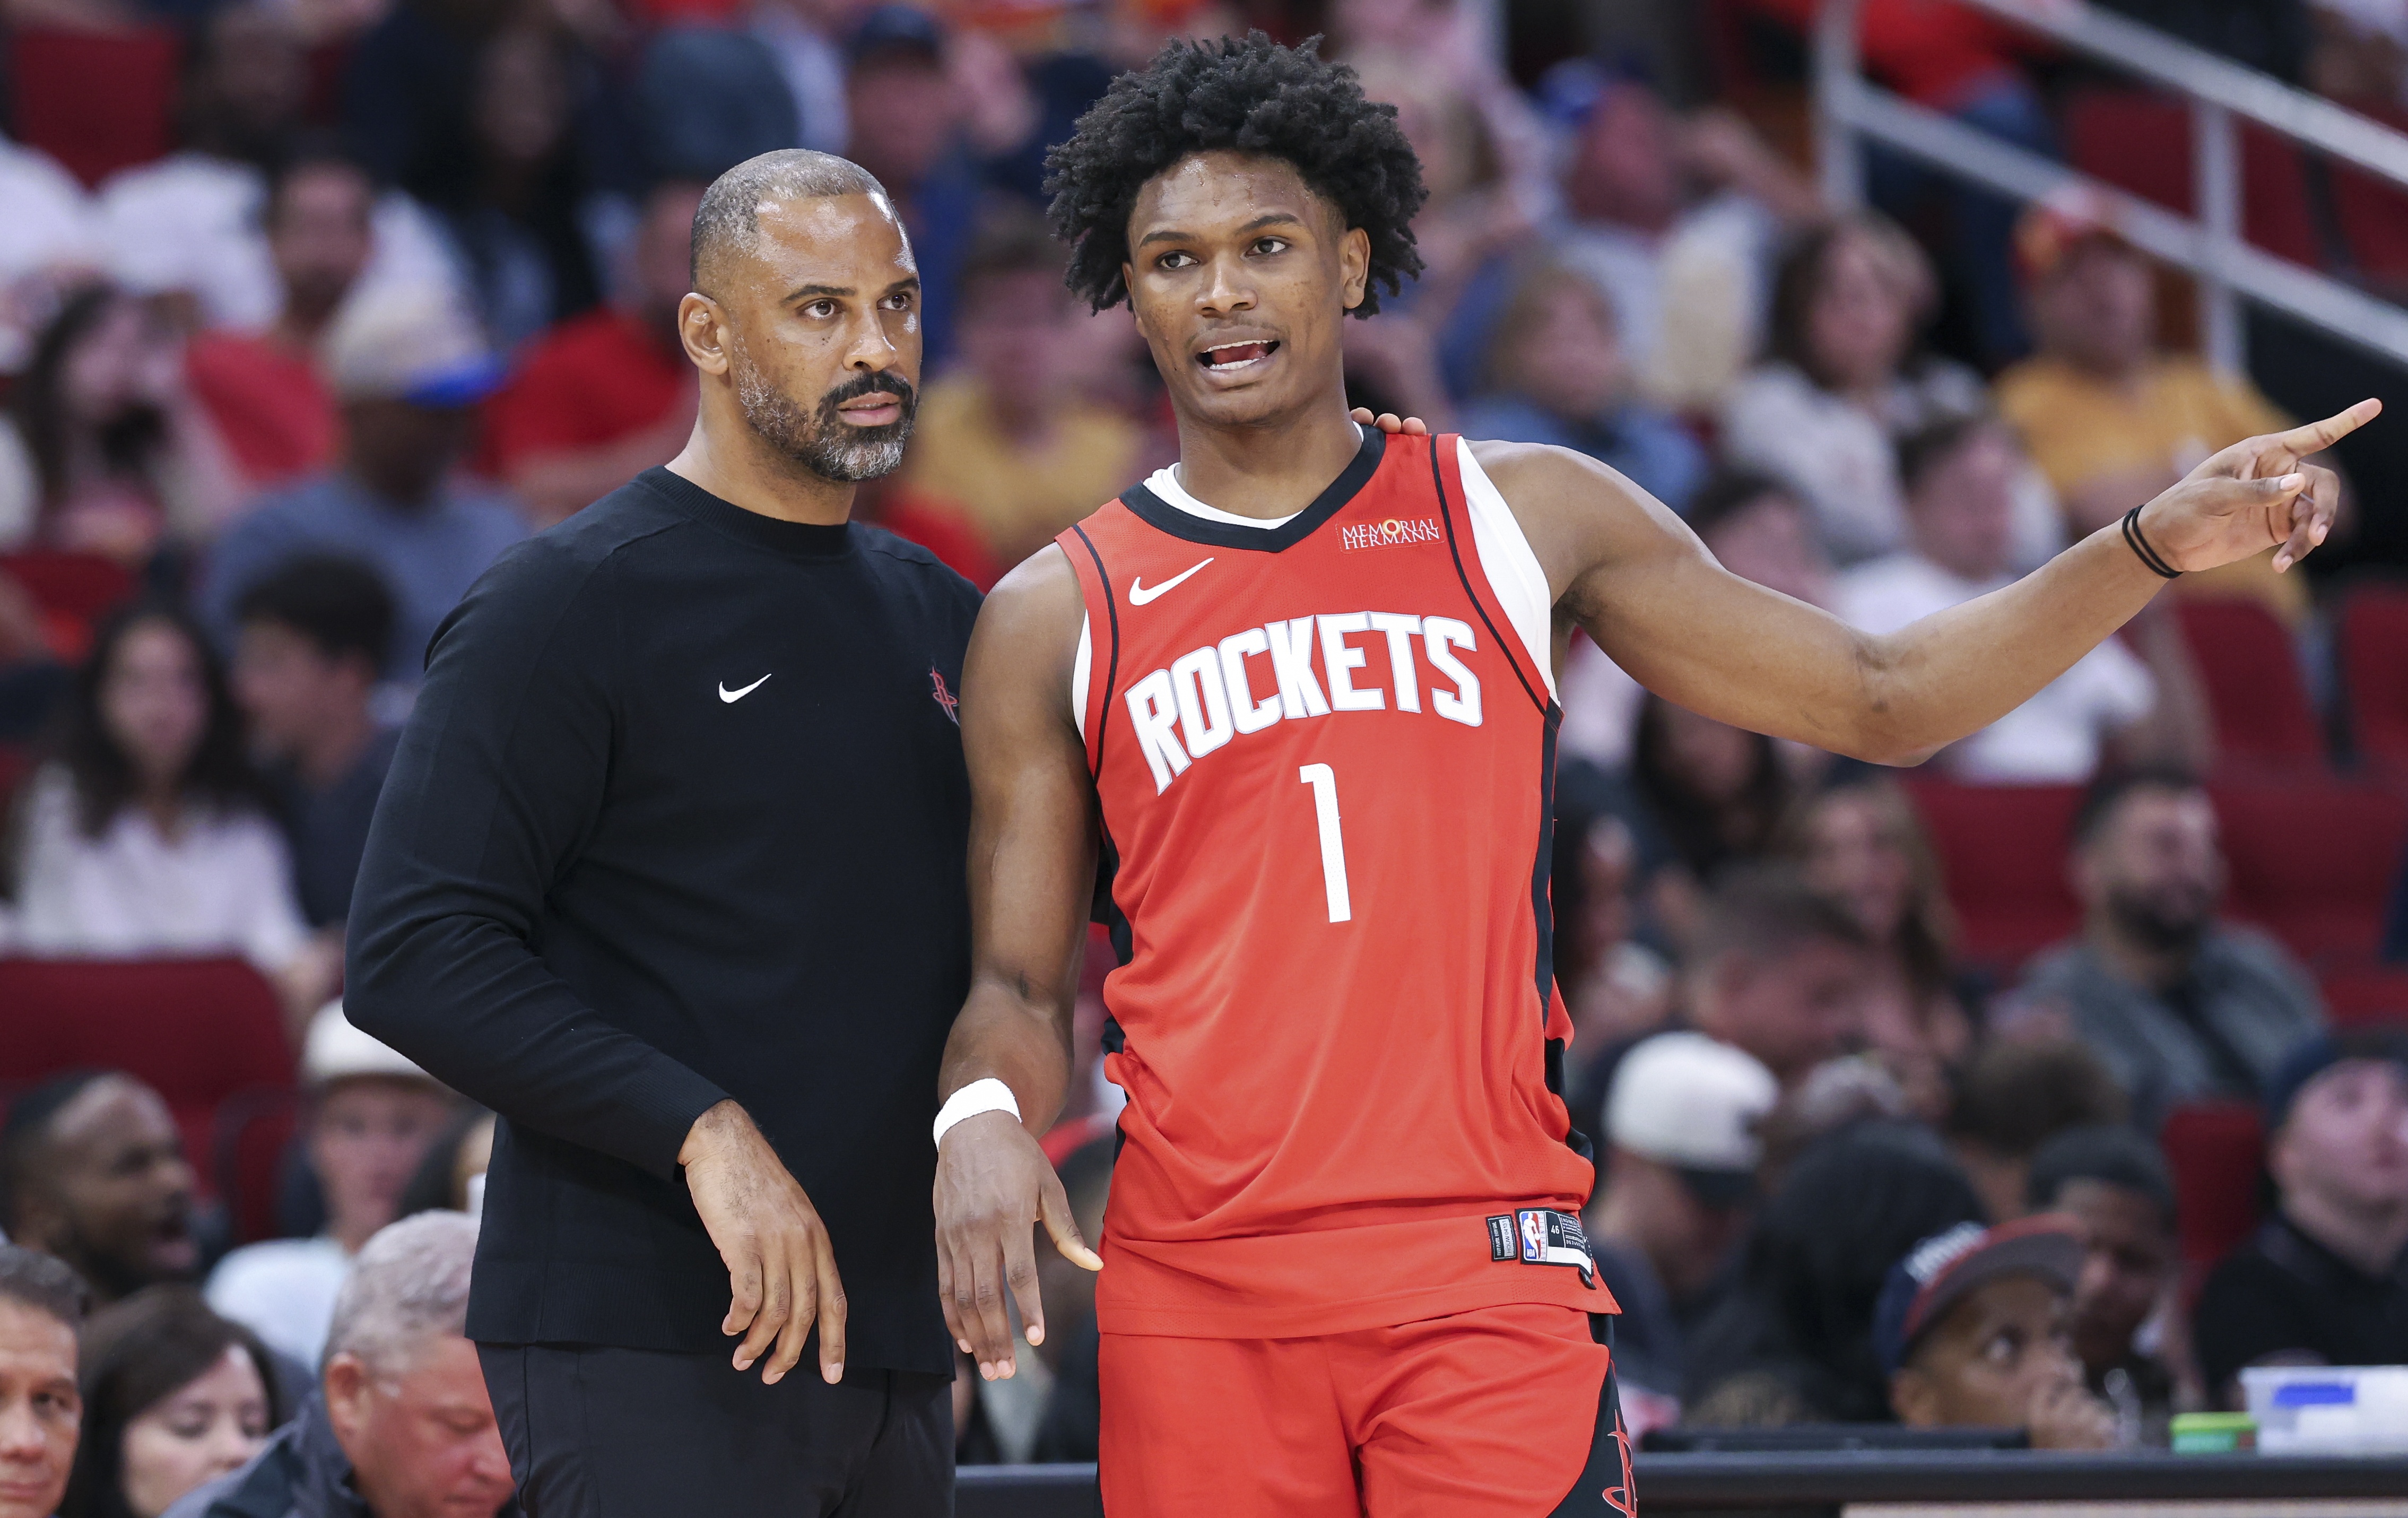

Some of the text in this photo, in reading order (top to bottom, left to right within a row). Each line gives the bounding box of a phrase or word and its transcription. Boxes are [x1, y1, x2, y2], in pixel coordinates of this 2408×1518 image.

[1342, 518, 1439, 540] MEMORIAL
[1344, 527, 1440, 550] HERMANN
[1124, 610, 1483, 797] ROCKETS
[1299, 762, 1352, 923] 1
[1551, 1225, 1560, 1235] 46
[1526, 1248, 1536, 1258] NBA
